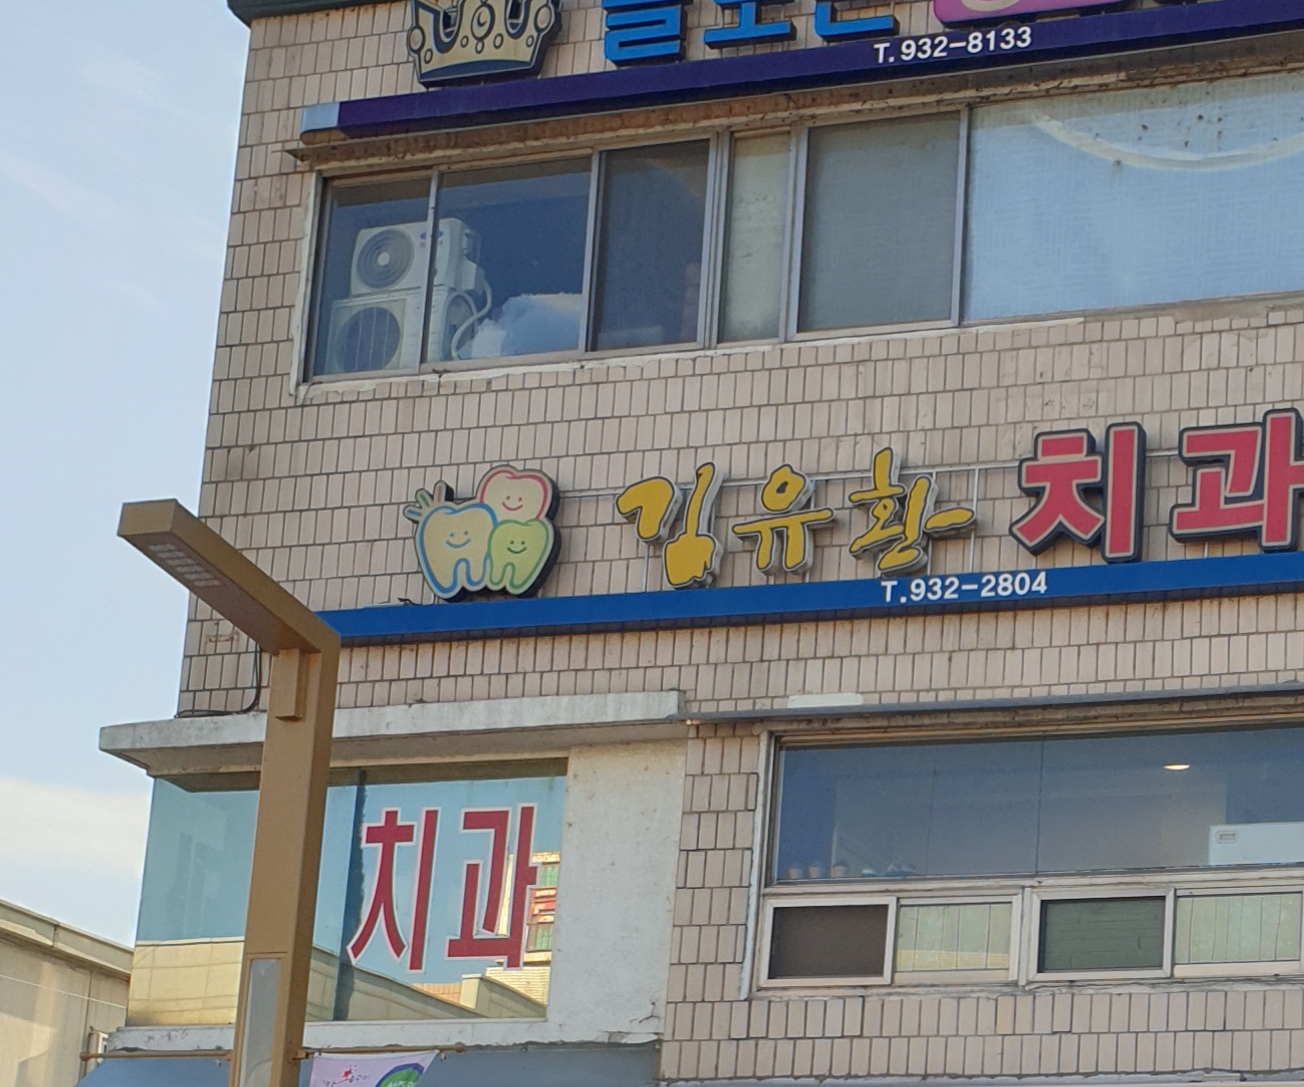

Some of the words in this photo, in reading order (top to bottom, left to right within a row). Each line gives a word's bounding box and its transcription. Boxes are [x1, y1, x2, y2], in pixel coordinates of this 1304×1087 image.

[616, 447, 974, 587] 김유환
[881, 571, 1048, 604] T.932-2804
[348, 804, 538, 971] 치과
